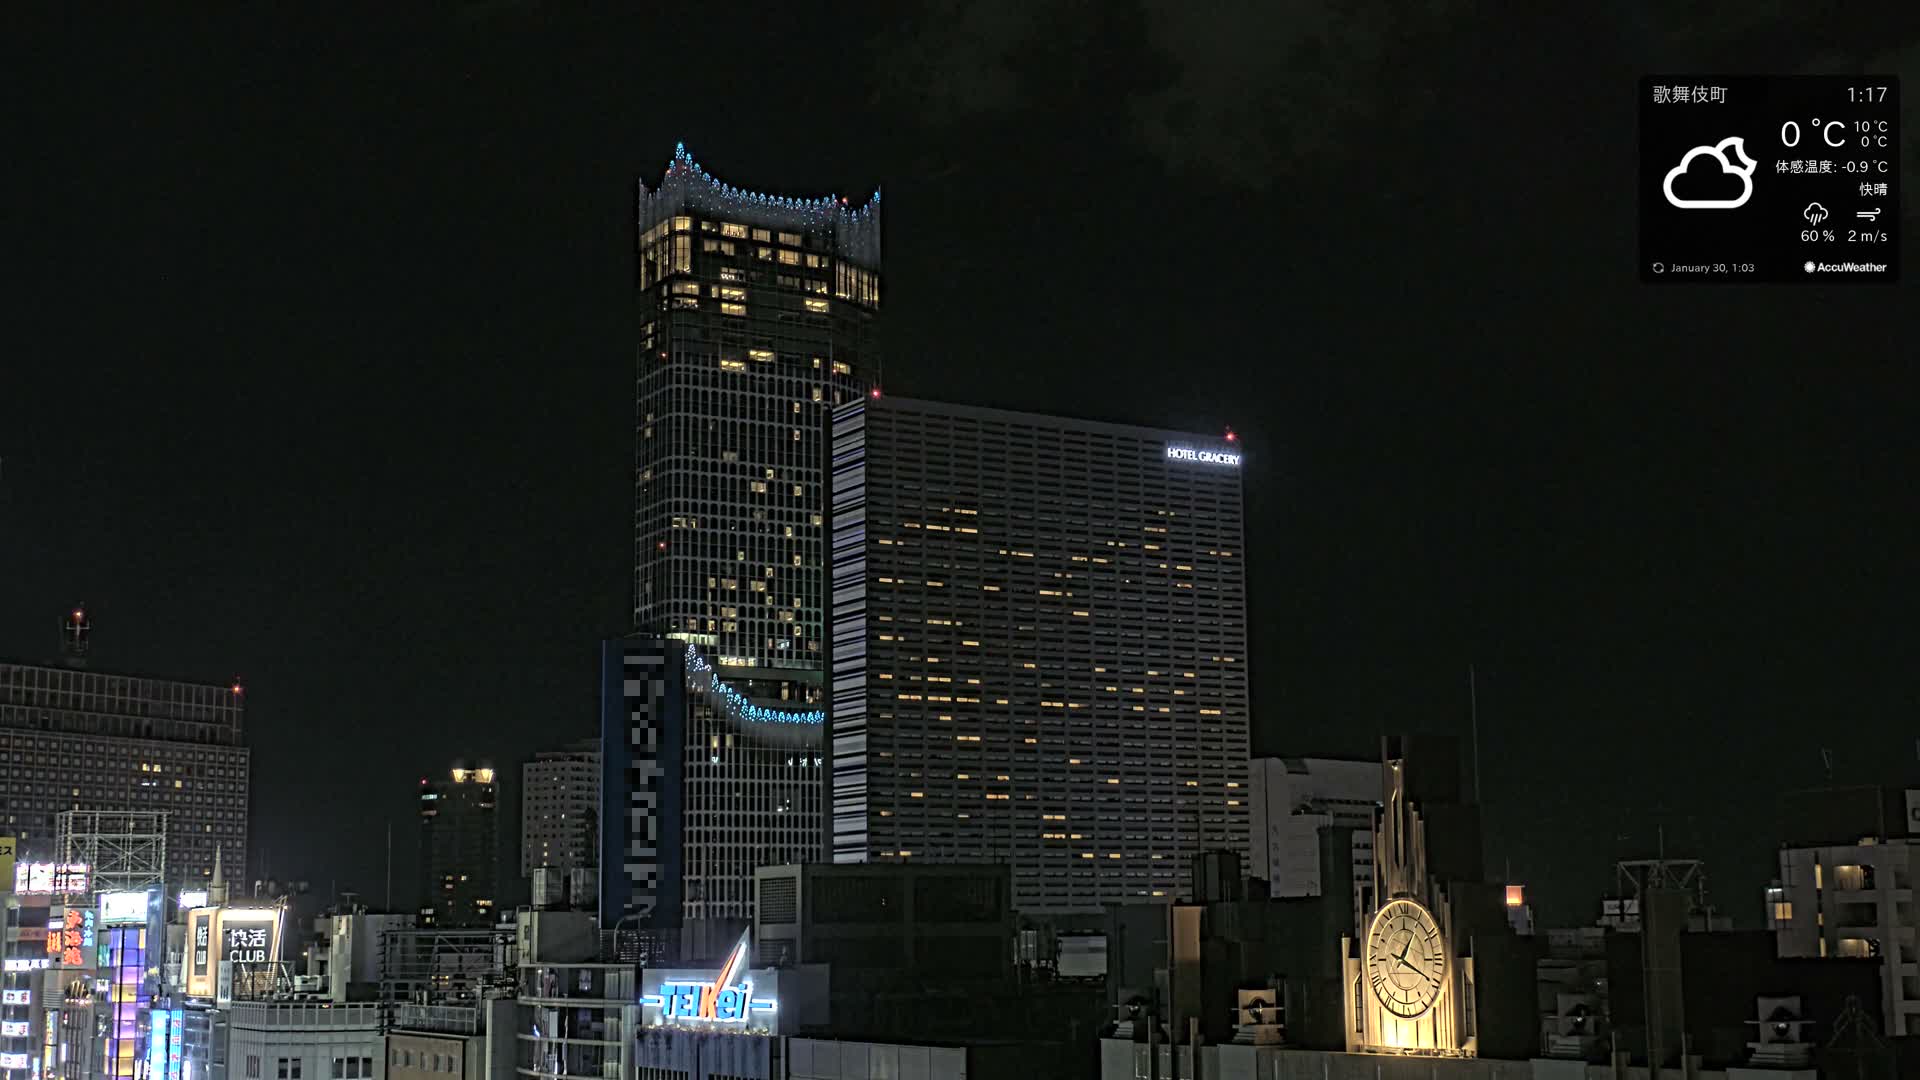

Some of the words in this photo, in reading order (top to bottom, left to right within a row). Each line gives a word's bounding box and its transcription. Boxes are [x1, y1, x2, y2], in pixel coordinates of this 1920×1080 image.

[1167, 447, 1198, 461] HOTEL
[1198, 451, 1240, 465] GRACERY
[0, 847, 12, 856] ス
[229, 928, 267, 948] 快活
[230, 949, 265, 963] CLUB
